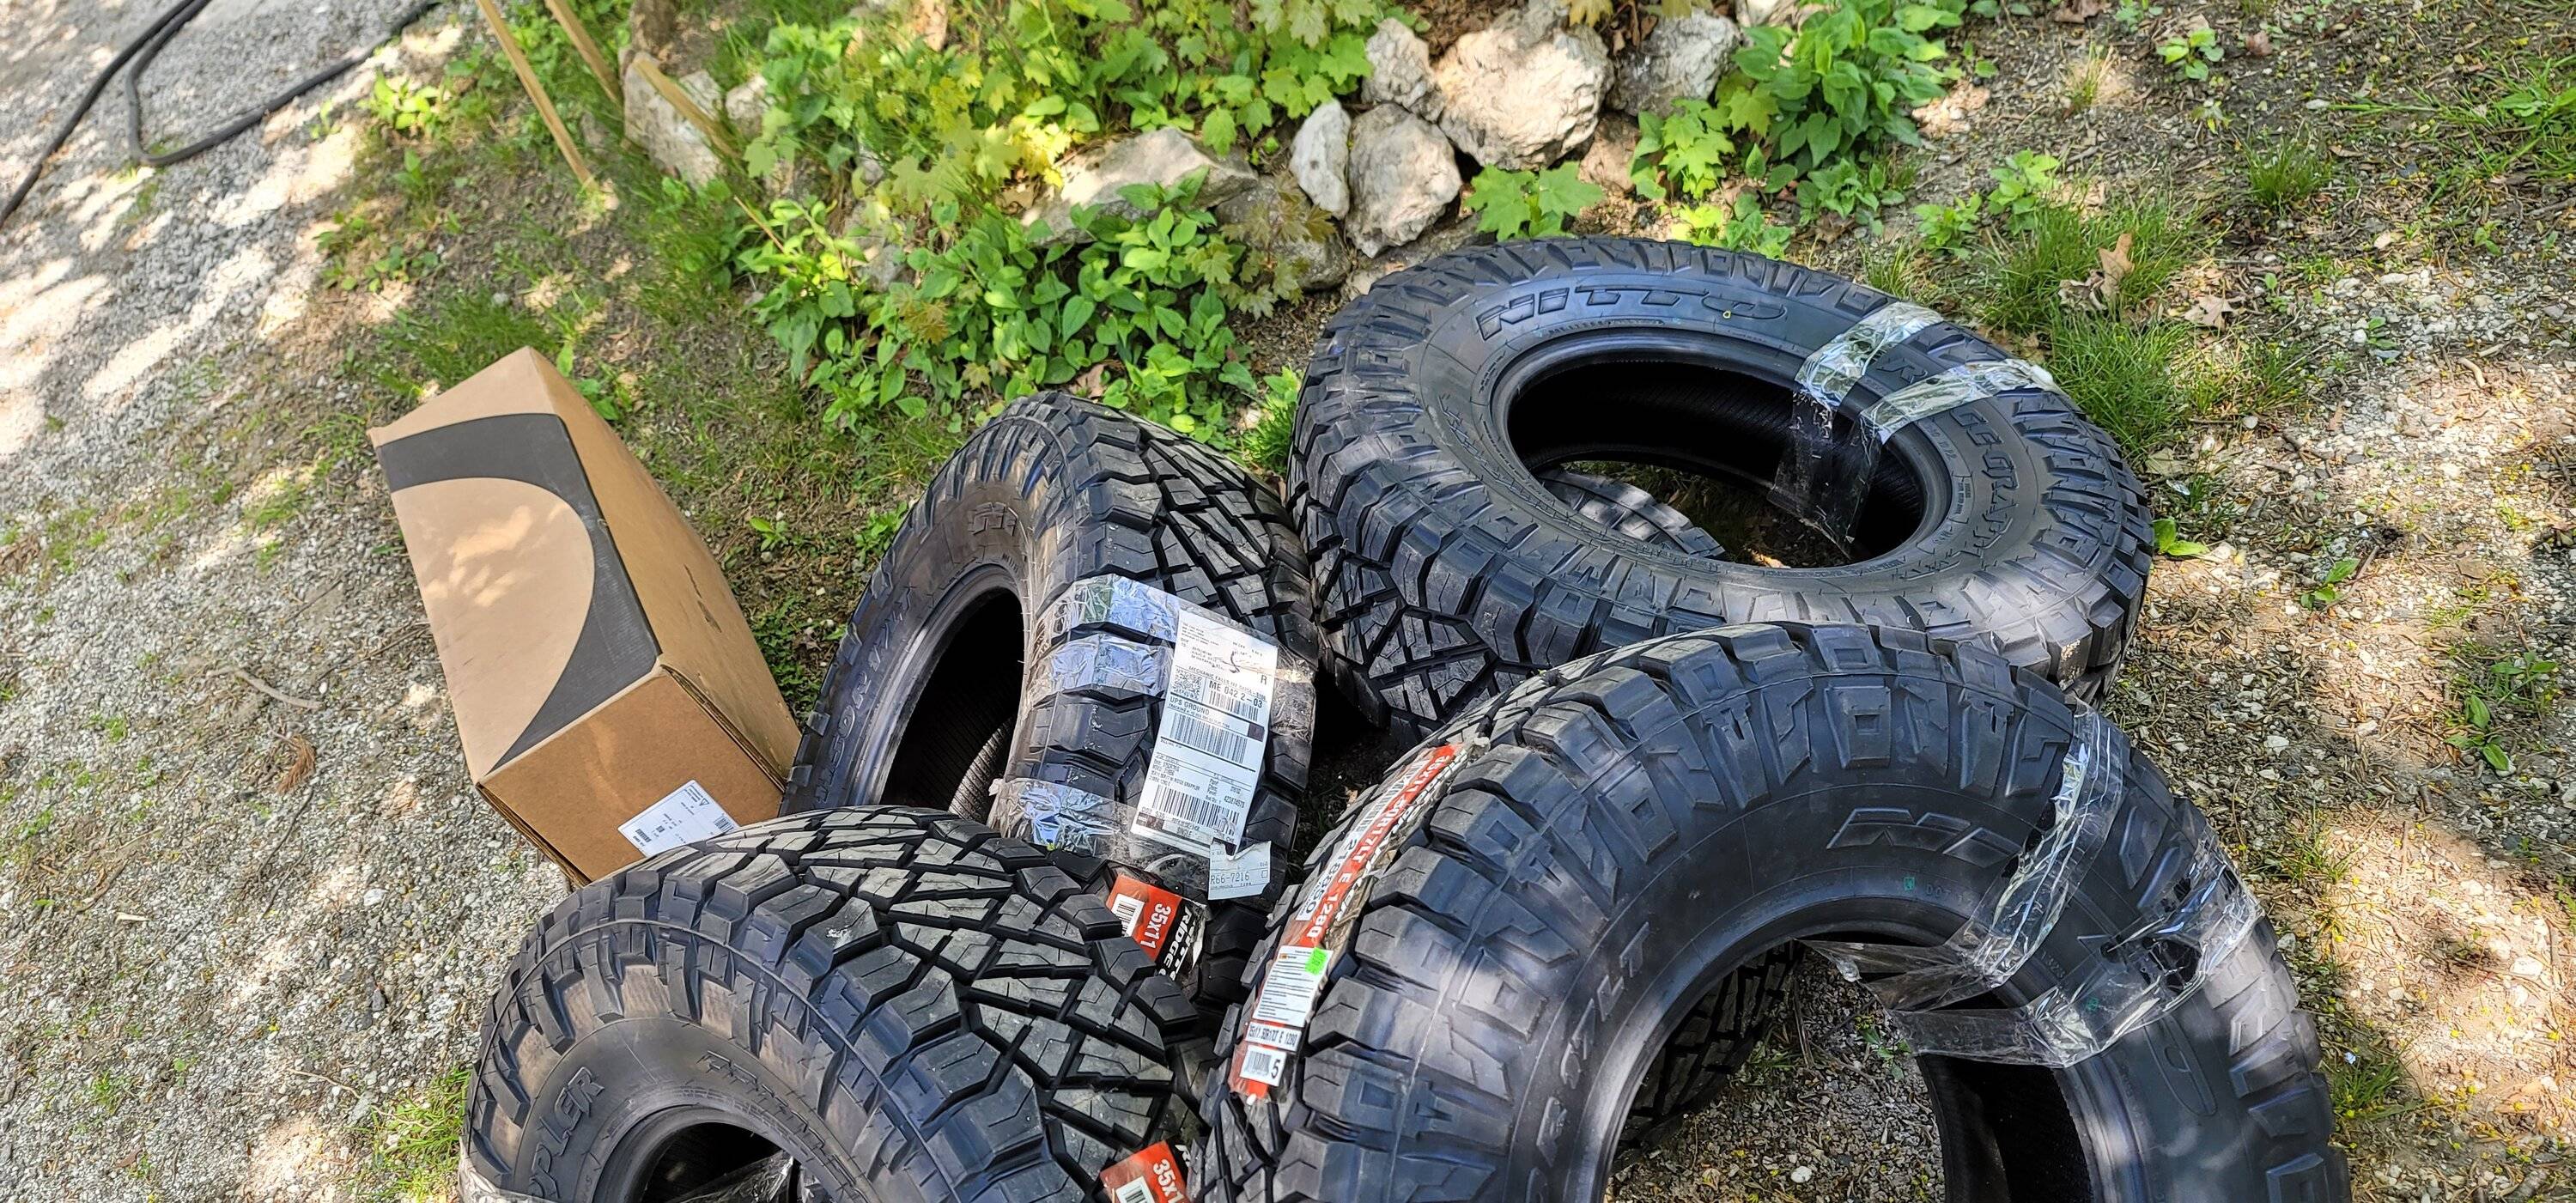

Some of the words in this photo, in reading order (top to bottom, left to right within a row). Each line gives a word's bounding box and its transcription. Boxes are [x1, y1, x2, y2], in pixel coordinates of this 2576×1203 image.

[1475, 284, 1788, 341] NITTO
[1209, 680, 1221, 692] ME
[1224, 686, 1238, 698] 042
[1260, 674, 1267, 685] R
[1170, 696, 1182, 706] UPS
[1184, 701, 1210, 715] GROUND
[1338, 872, 1352, 884] E
[1306, 893, 1339, 939] 1280
[1163, 906, 1193, 968] RIDGE
[1271, 1059, 1281, 1079] 5
